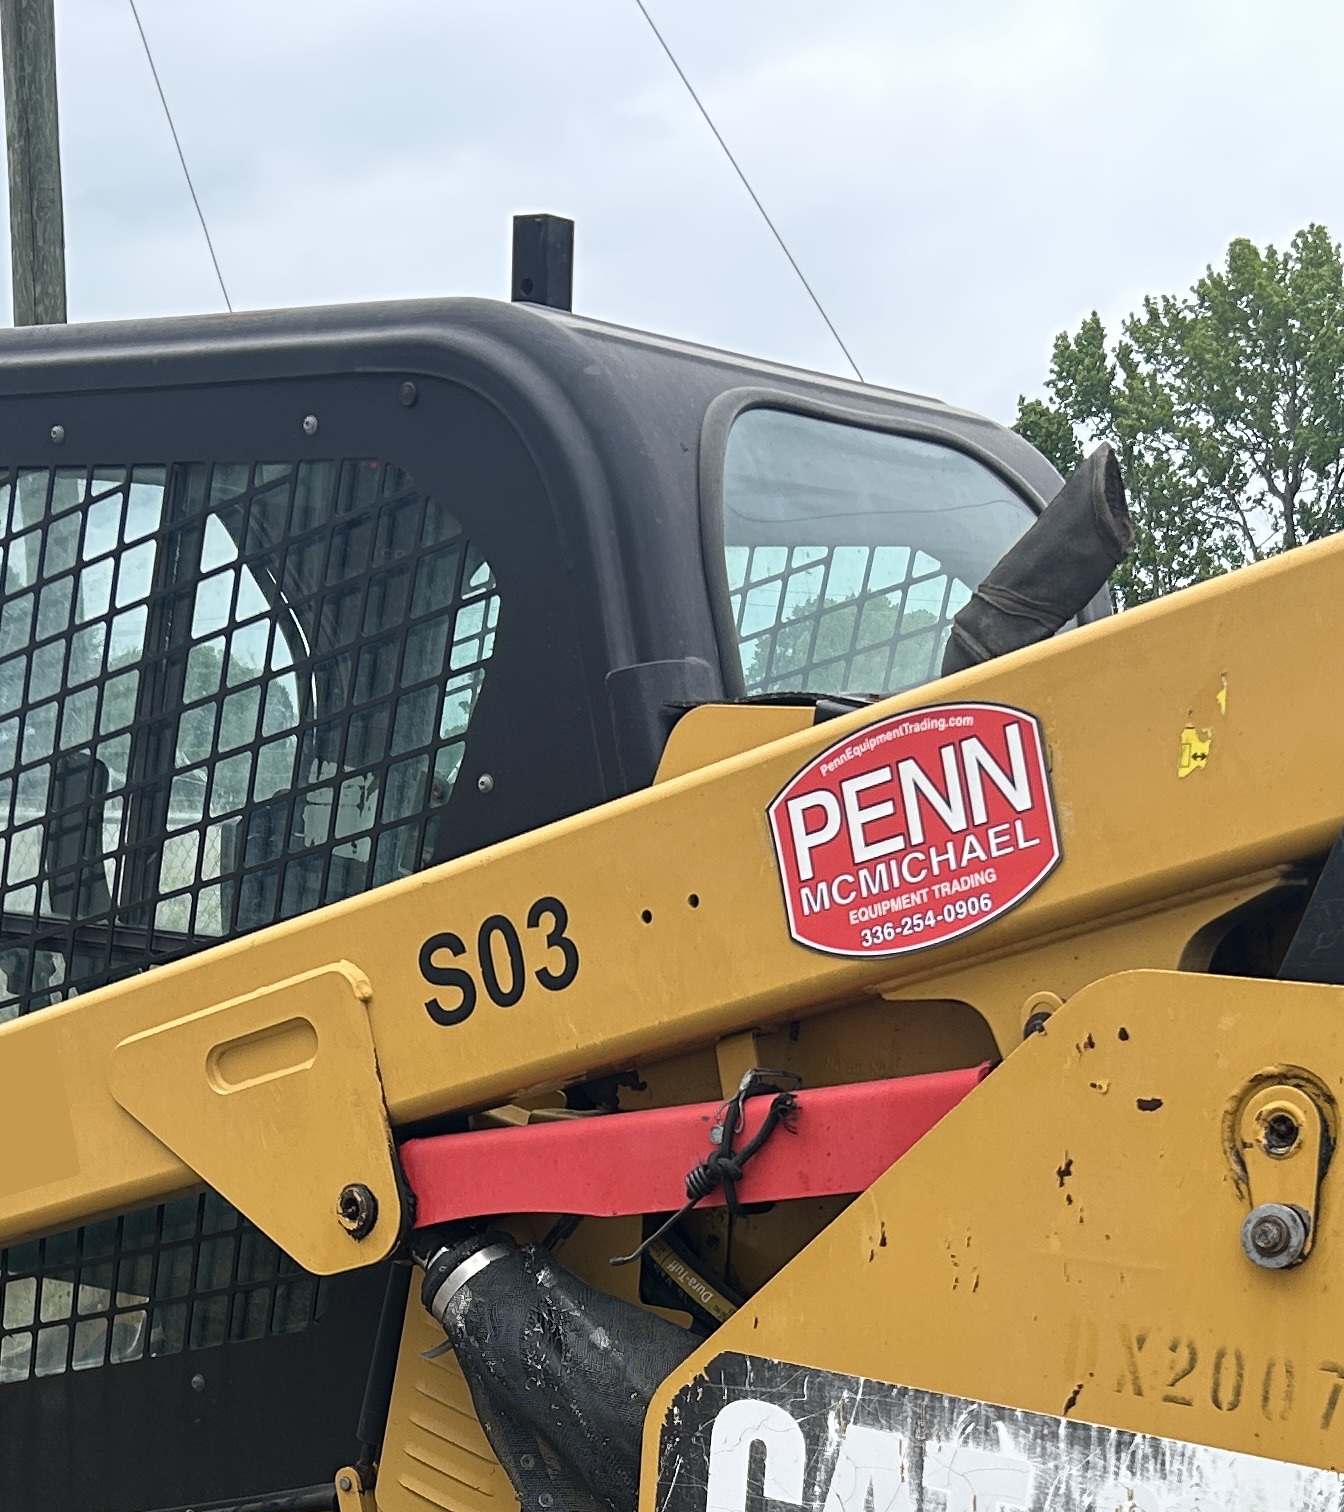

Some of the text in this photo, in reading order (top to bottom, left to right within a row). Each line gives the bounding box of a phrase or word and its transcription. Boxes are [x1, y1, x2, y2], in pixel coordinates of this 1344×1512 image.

[820, 715, 974, 777] PennEquipmentTrading.com
[787, 722, 1033, 881] PENN
[800, 819, 1041, 916] MCMICHAEL
[848, 868, 997, 925] EQUIPMENT TRADING
[860, 892, 993, 948] 336-254-0906
[419, 896, 579, 1026] S03
[666, 1258, 714, 1304] Dura-Tuff
